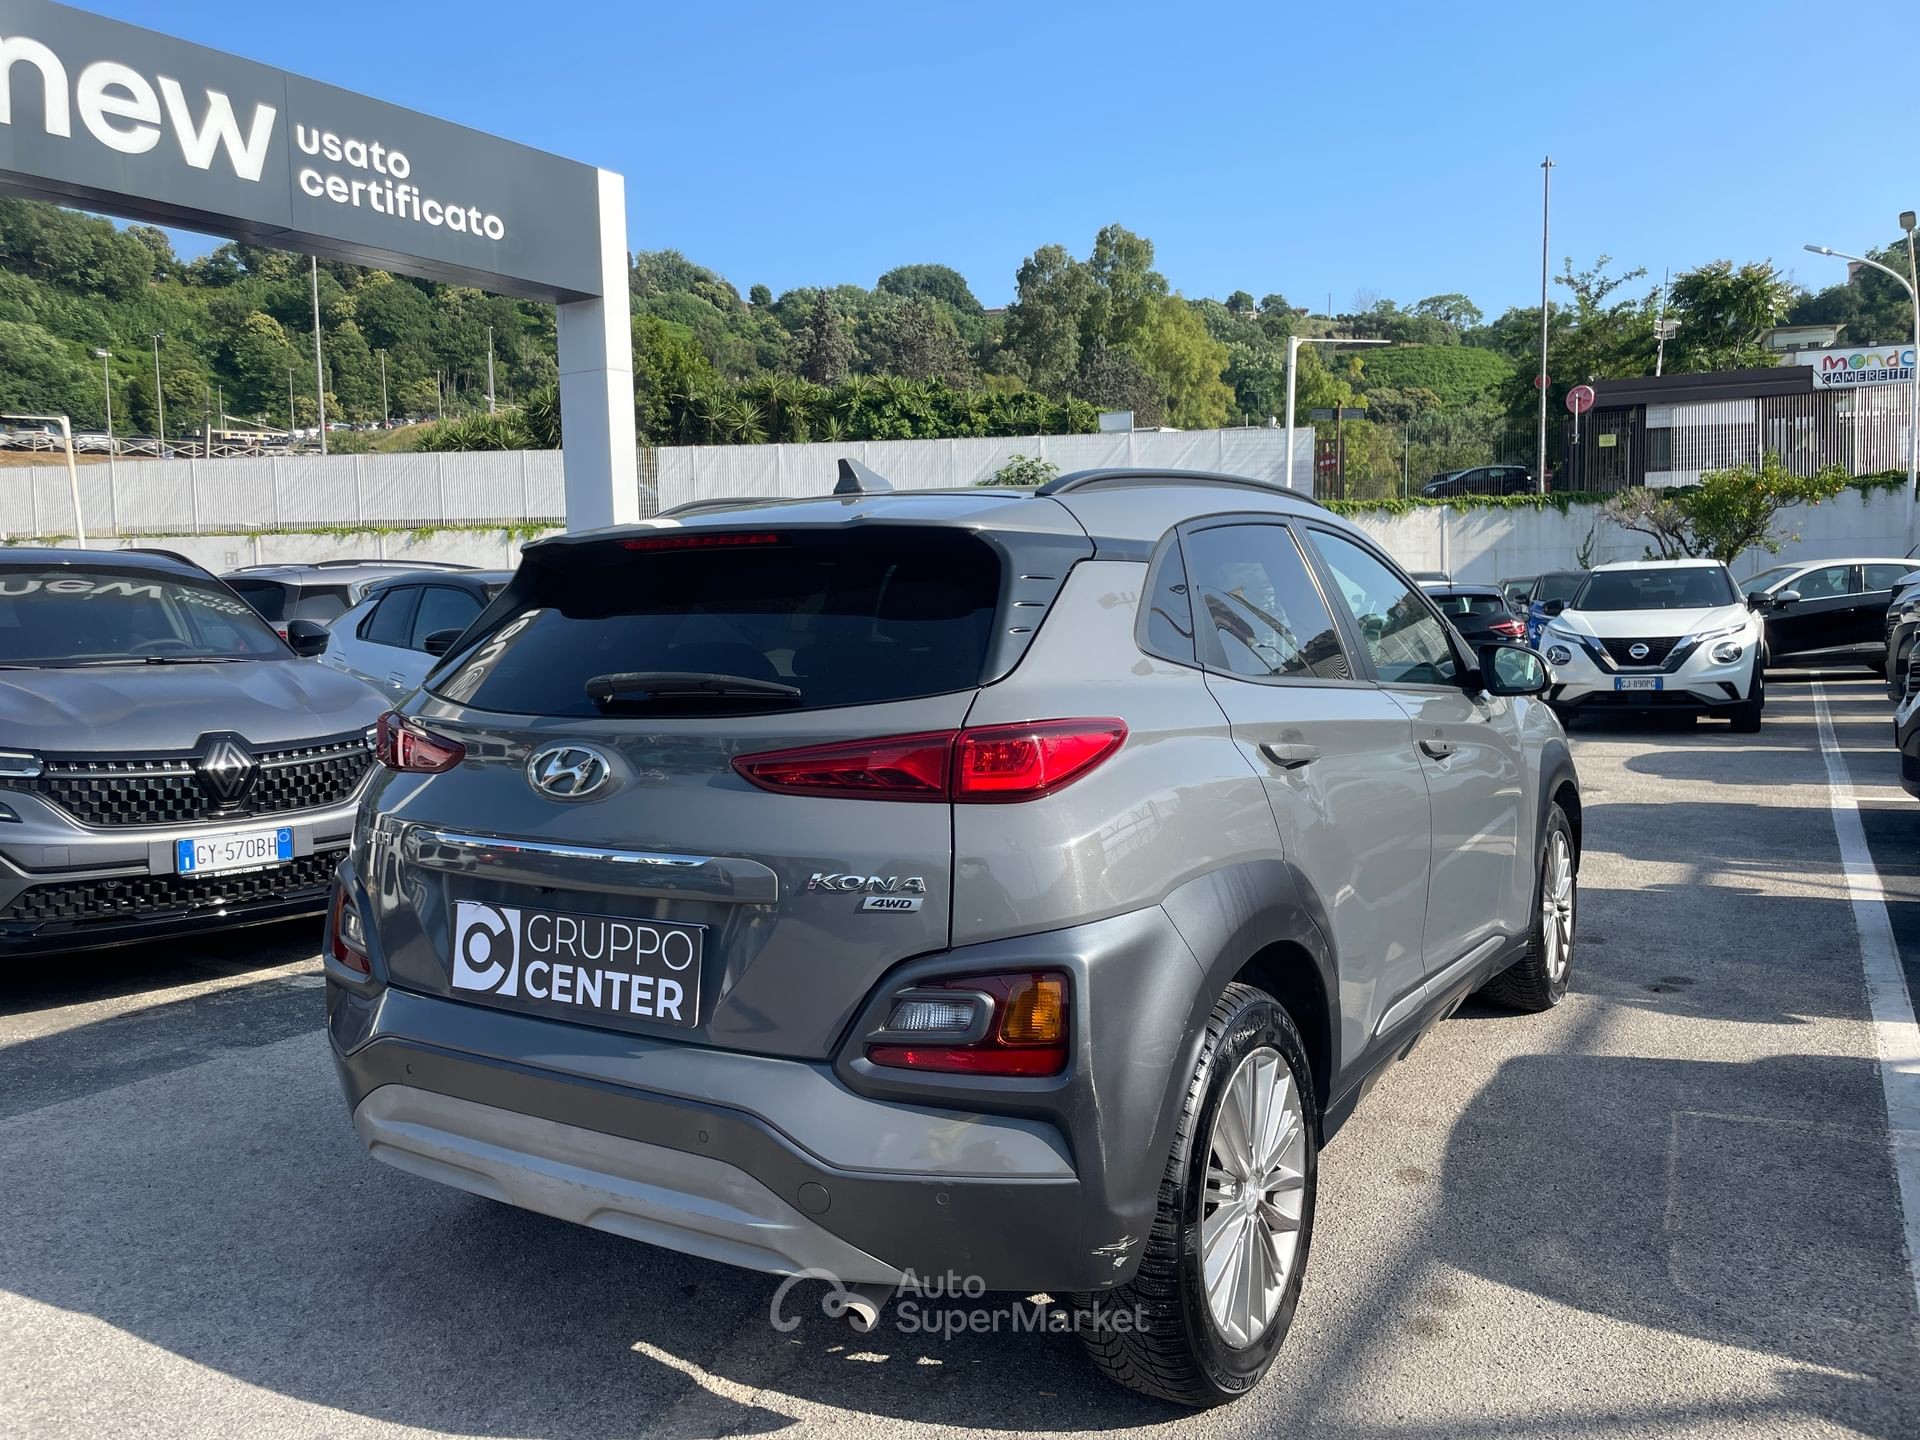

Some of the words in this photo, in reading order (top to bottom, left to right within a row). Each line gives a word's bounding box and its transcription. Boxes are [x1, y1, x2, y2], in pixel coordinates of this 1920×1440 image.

[0, 36, 277, 182] new
[296, 124, 411, 179] usato
[300, 168, 505, 241] certificato
[196, 844, 216, 865] GY
[225, 837, 278, 861] 570BH
[808, 873, 927, 894] KONA
[870, 898, 913, 910] 4WD
[527, 914, 694, 971] GRUPPO
[524, 960, 684, 1021] CENTER
